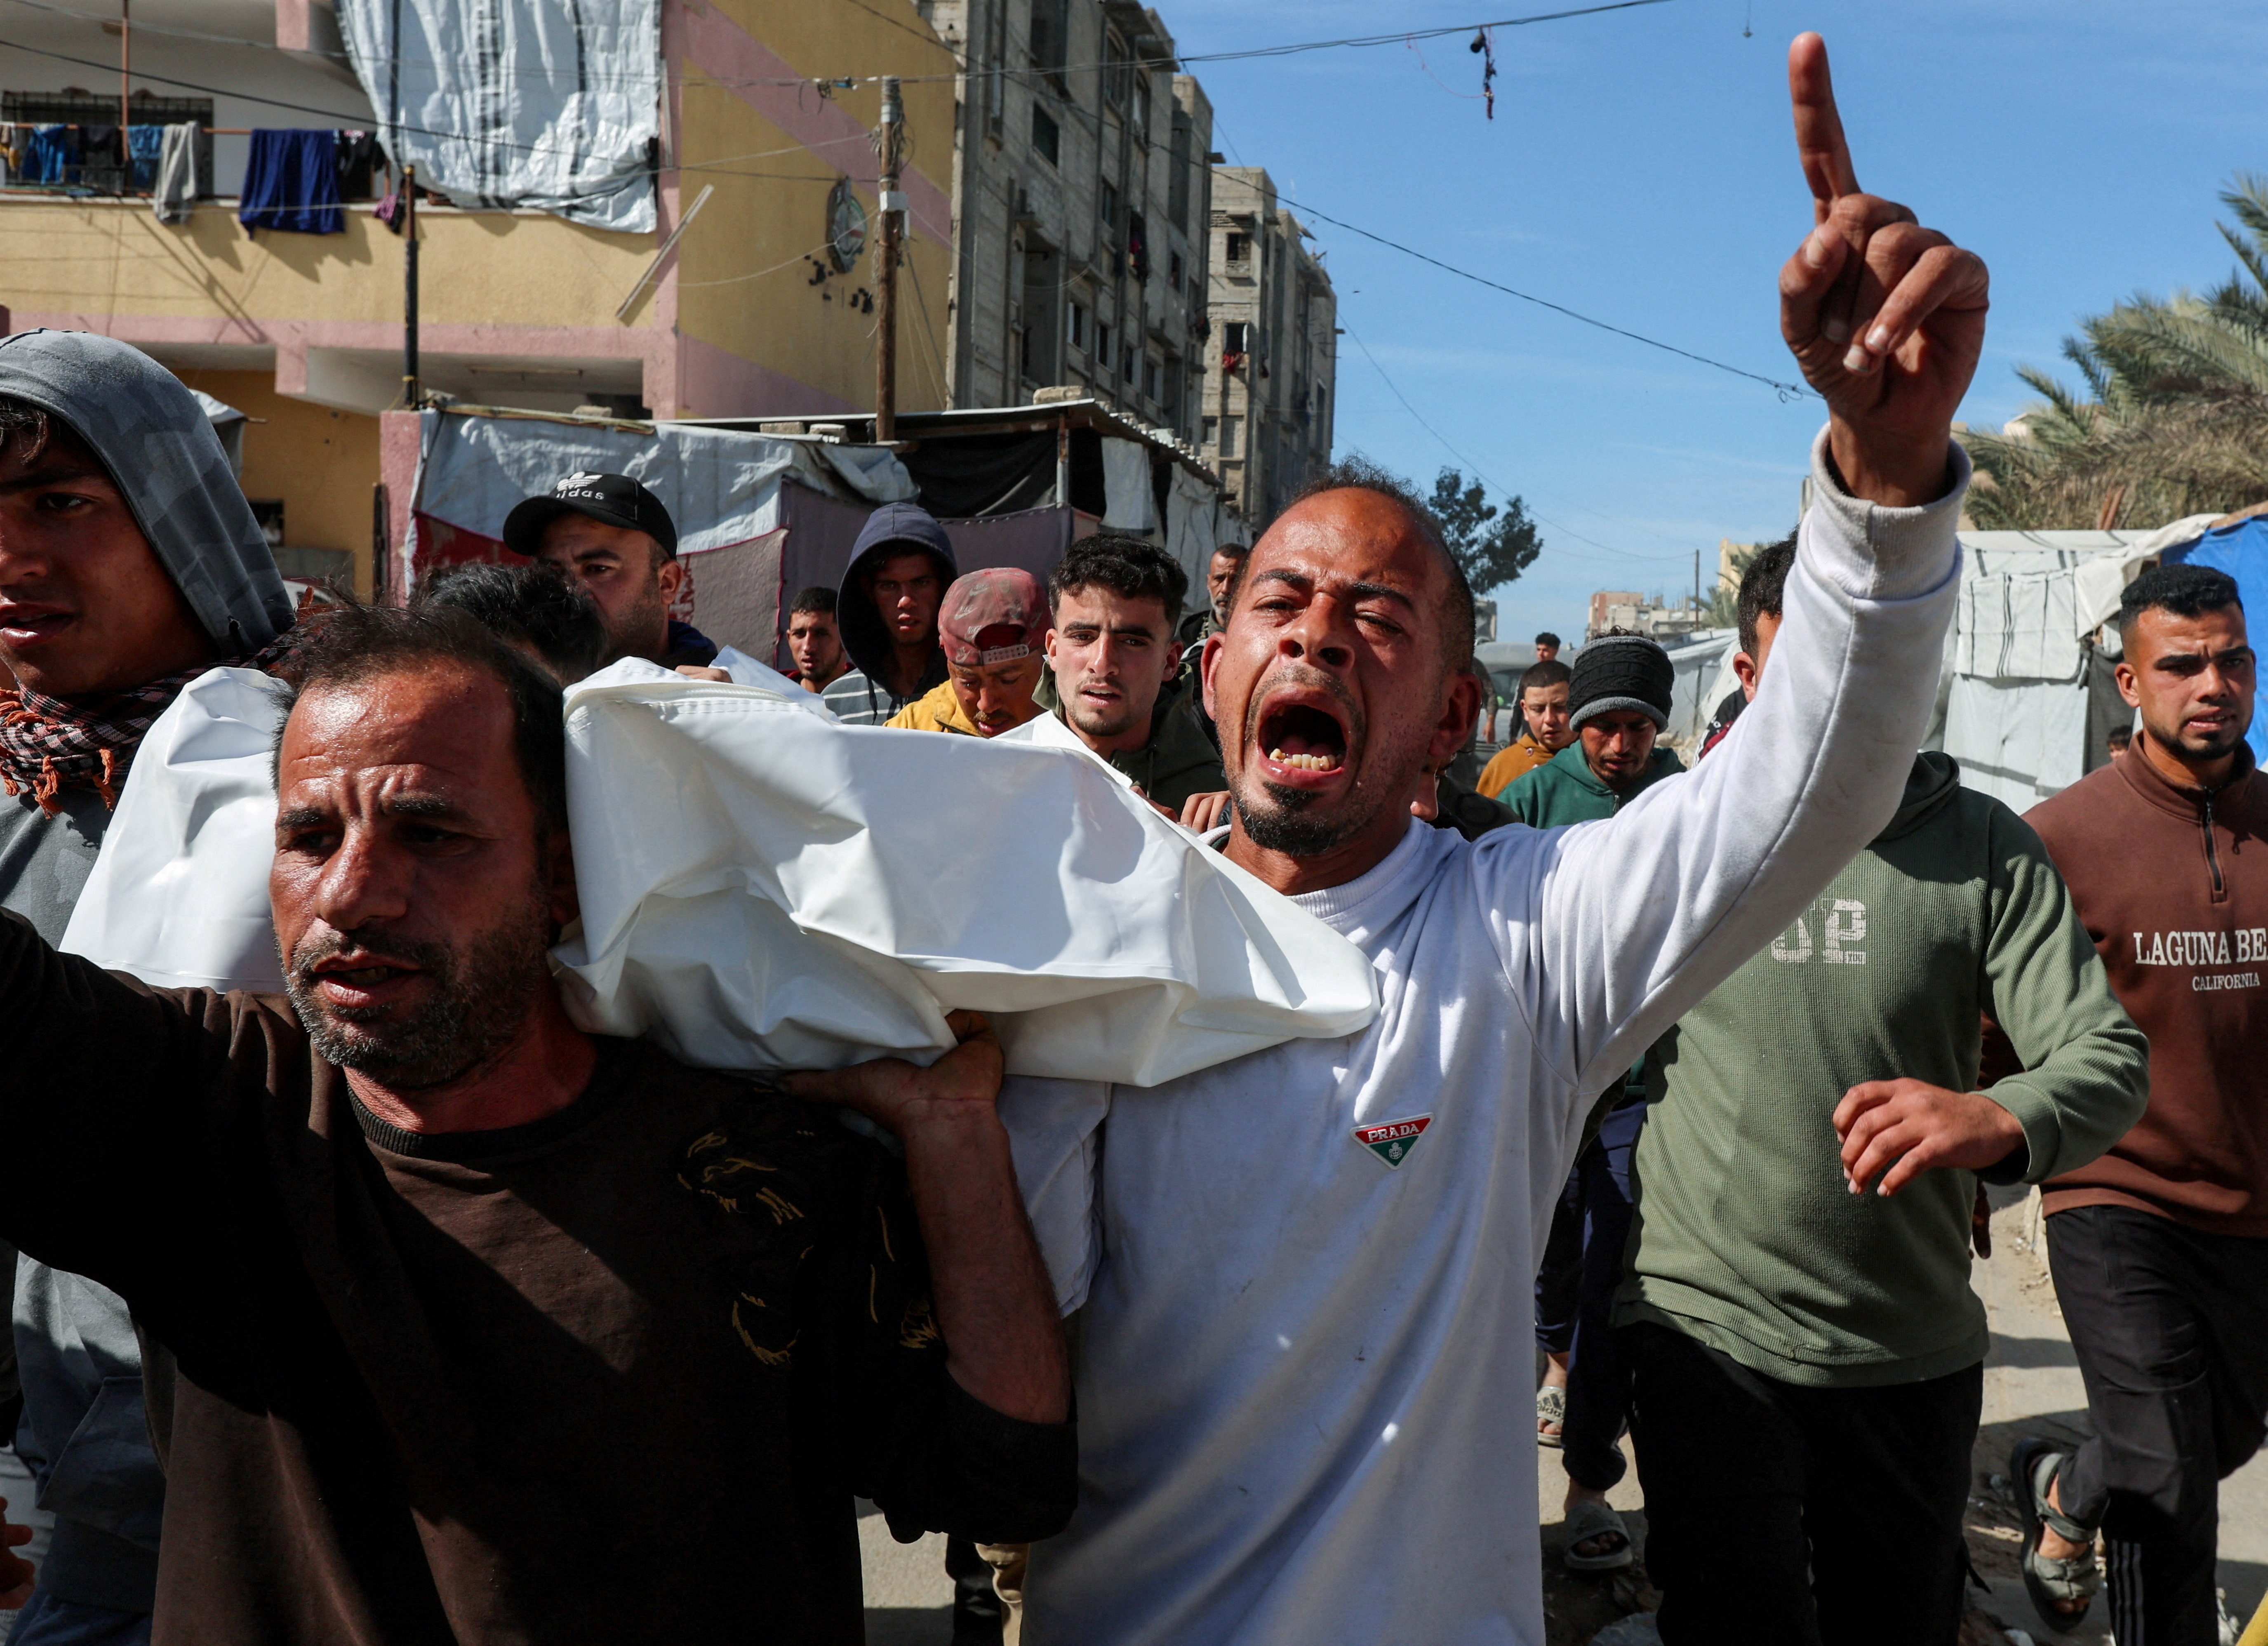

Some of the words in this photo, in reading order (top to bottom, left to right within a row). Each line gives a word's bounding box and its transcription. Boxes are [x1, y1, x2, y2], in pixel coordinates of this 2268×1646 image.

[556, 488, 604, 500] idas
[2133, 931, 2231, 966] LAGUNA
[2235, 928, 2268, 963] BE
[2192, 972, 2260, 991] CALIFORNIA
[1367, 1123, 1419, 1142] PRADA
